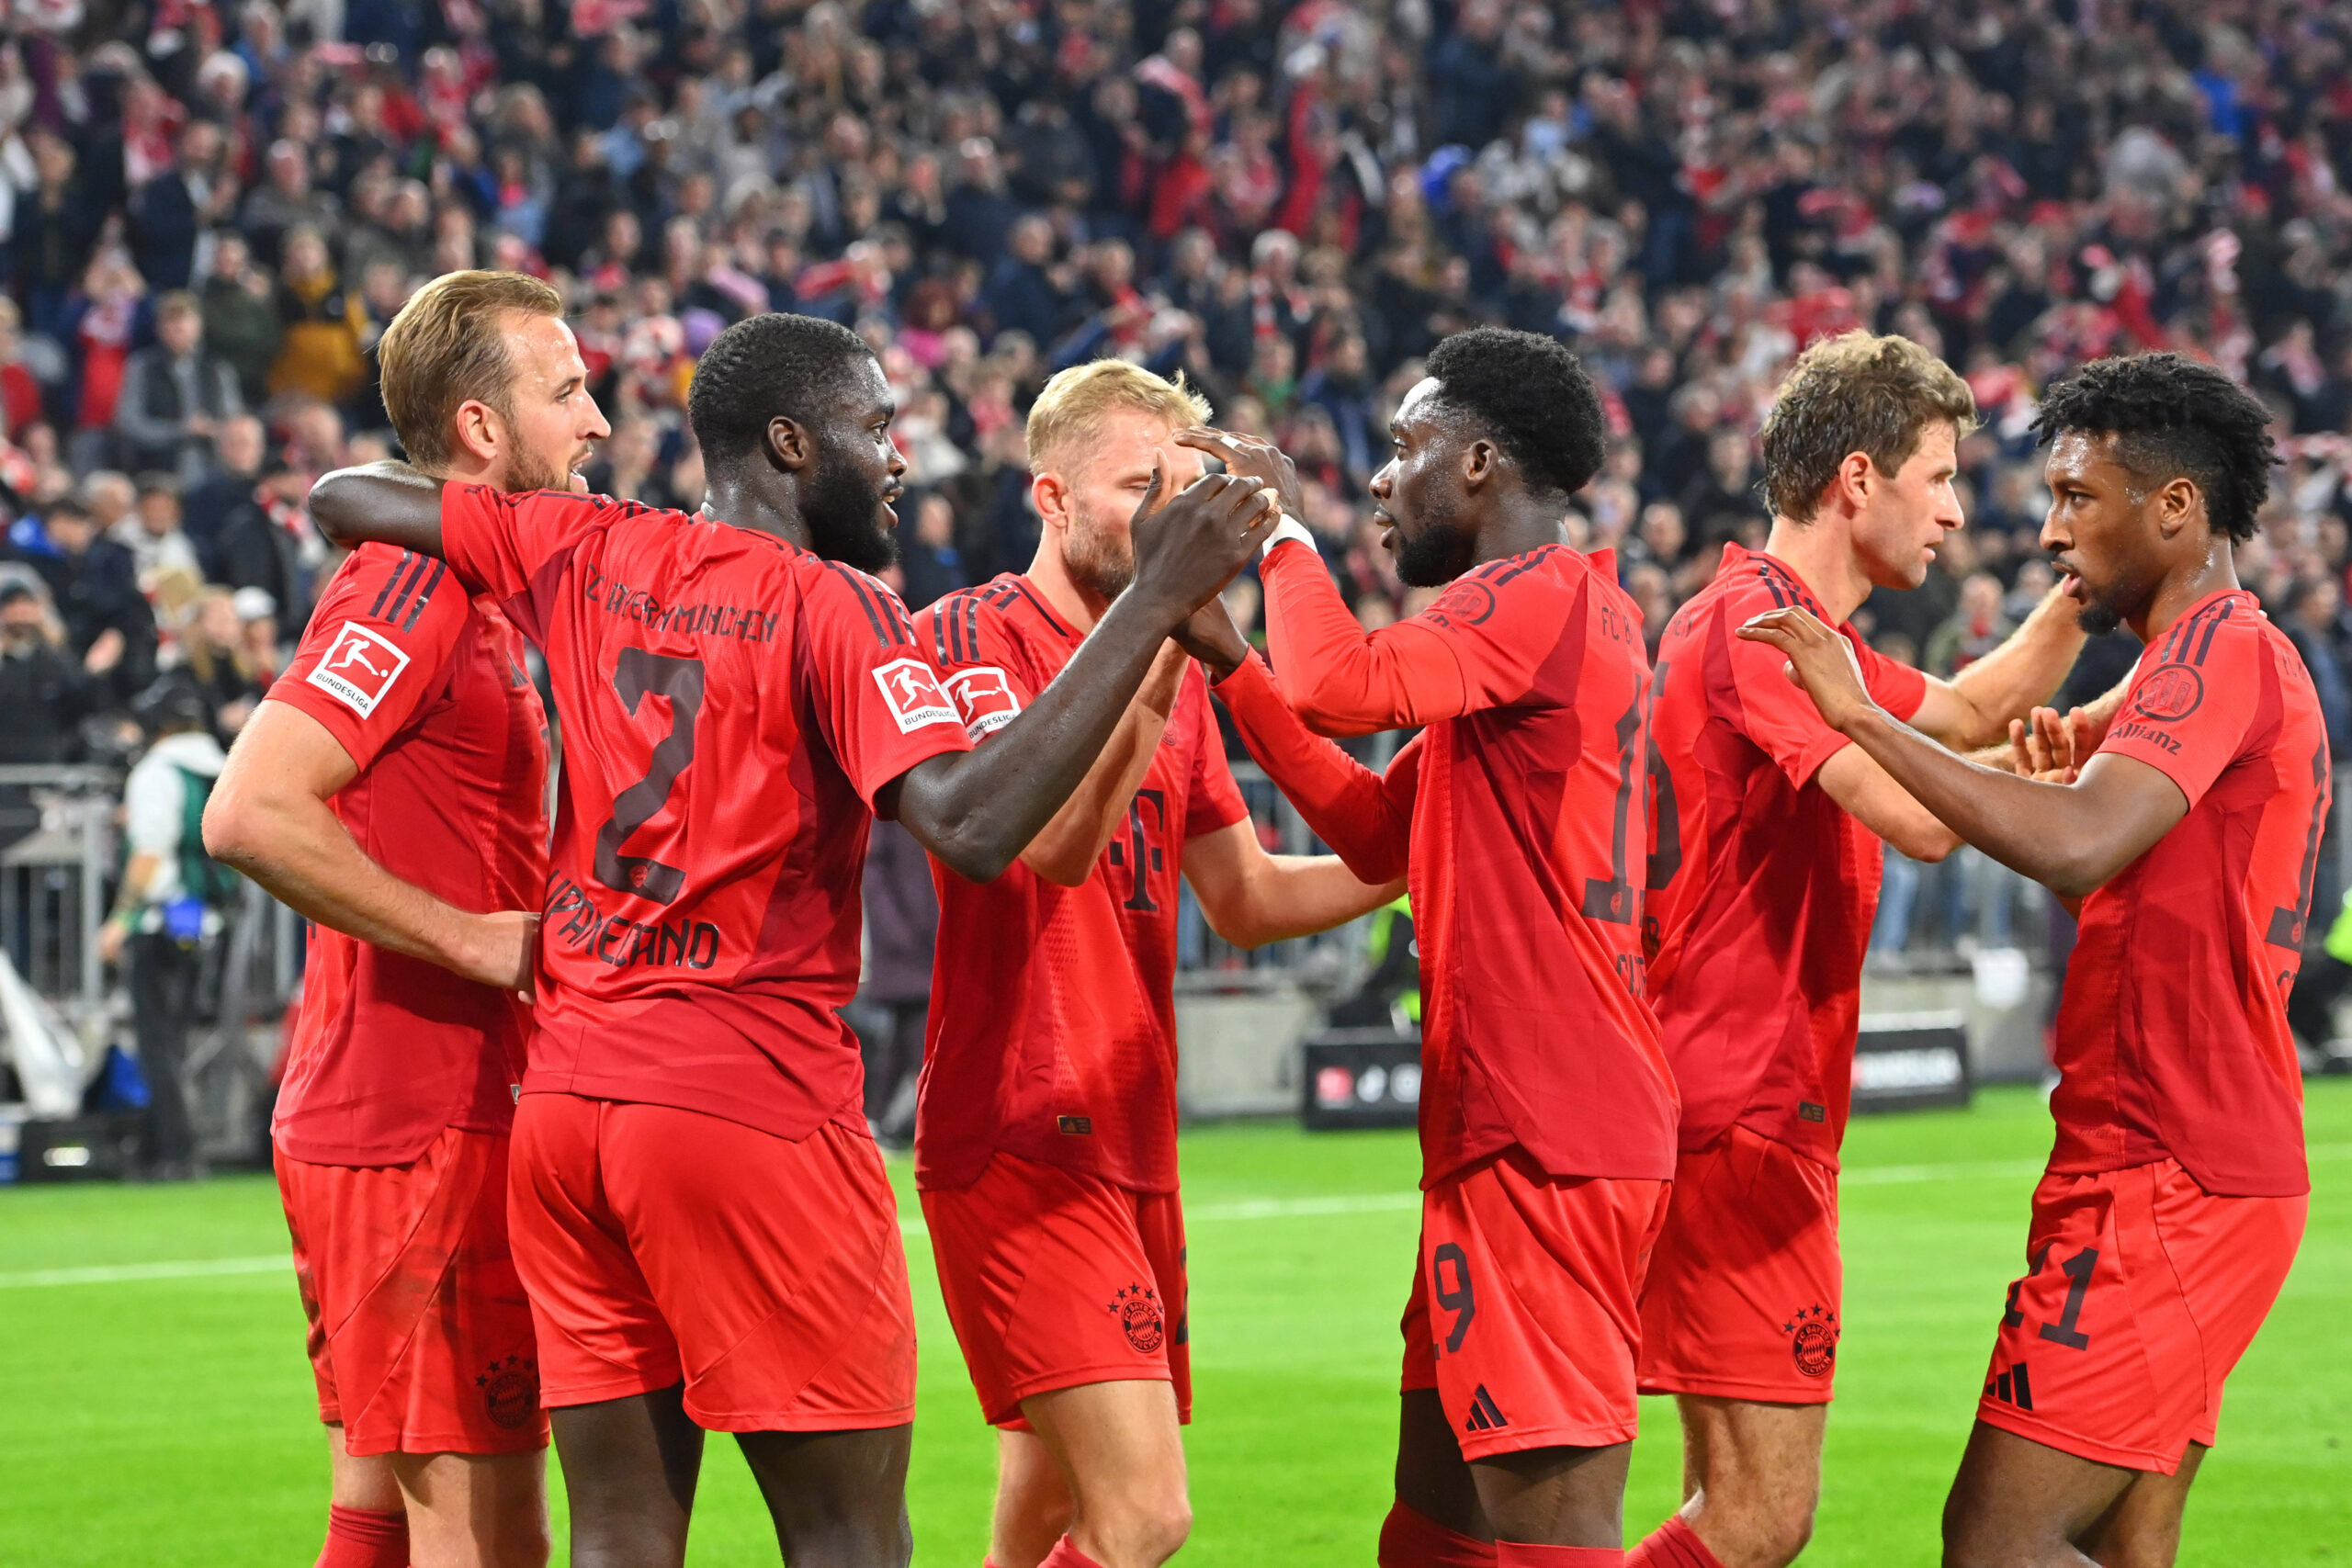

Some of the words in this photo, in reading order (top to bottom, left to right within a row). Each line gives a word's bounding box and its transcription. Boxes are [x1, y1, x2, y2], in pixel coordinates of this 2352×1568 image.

[315, 672, 369, 711] BUNDESLIGA
[904, 710, 957, 726] BUNDESLIGA
[2108, 722, 2183, 756] Allianz
[593, 646, 706, 907] 2
[1434, 1242, 1476, 1360] 9
